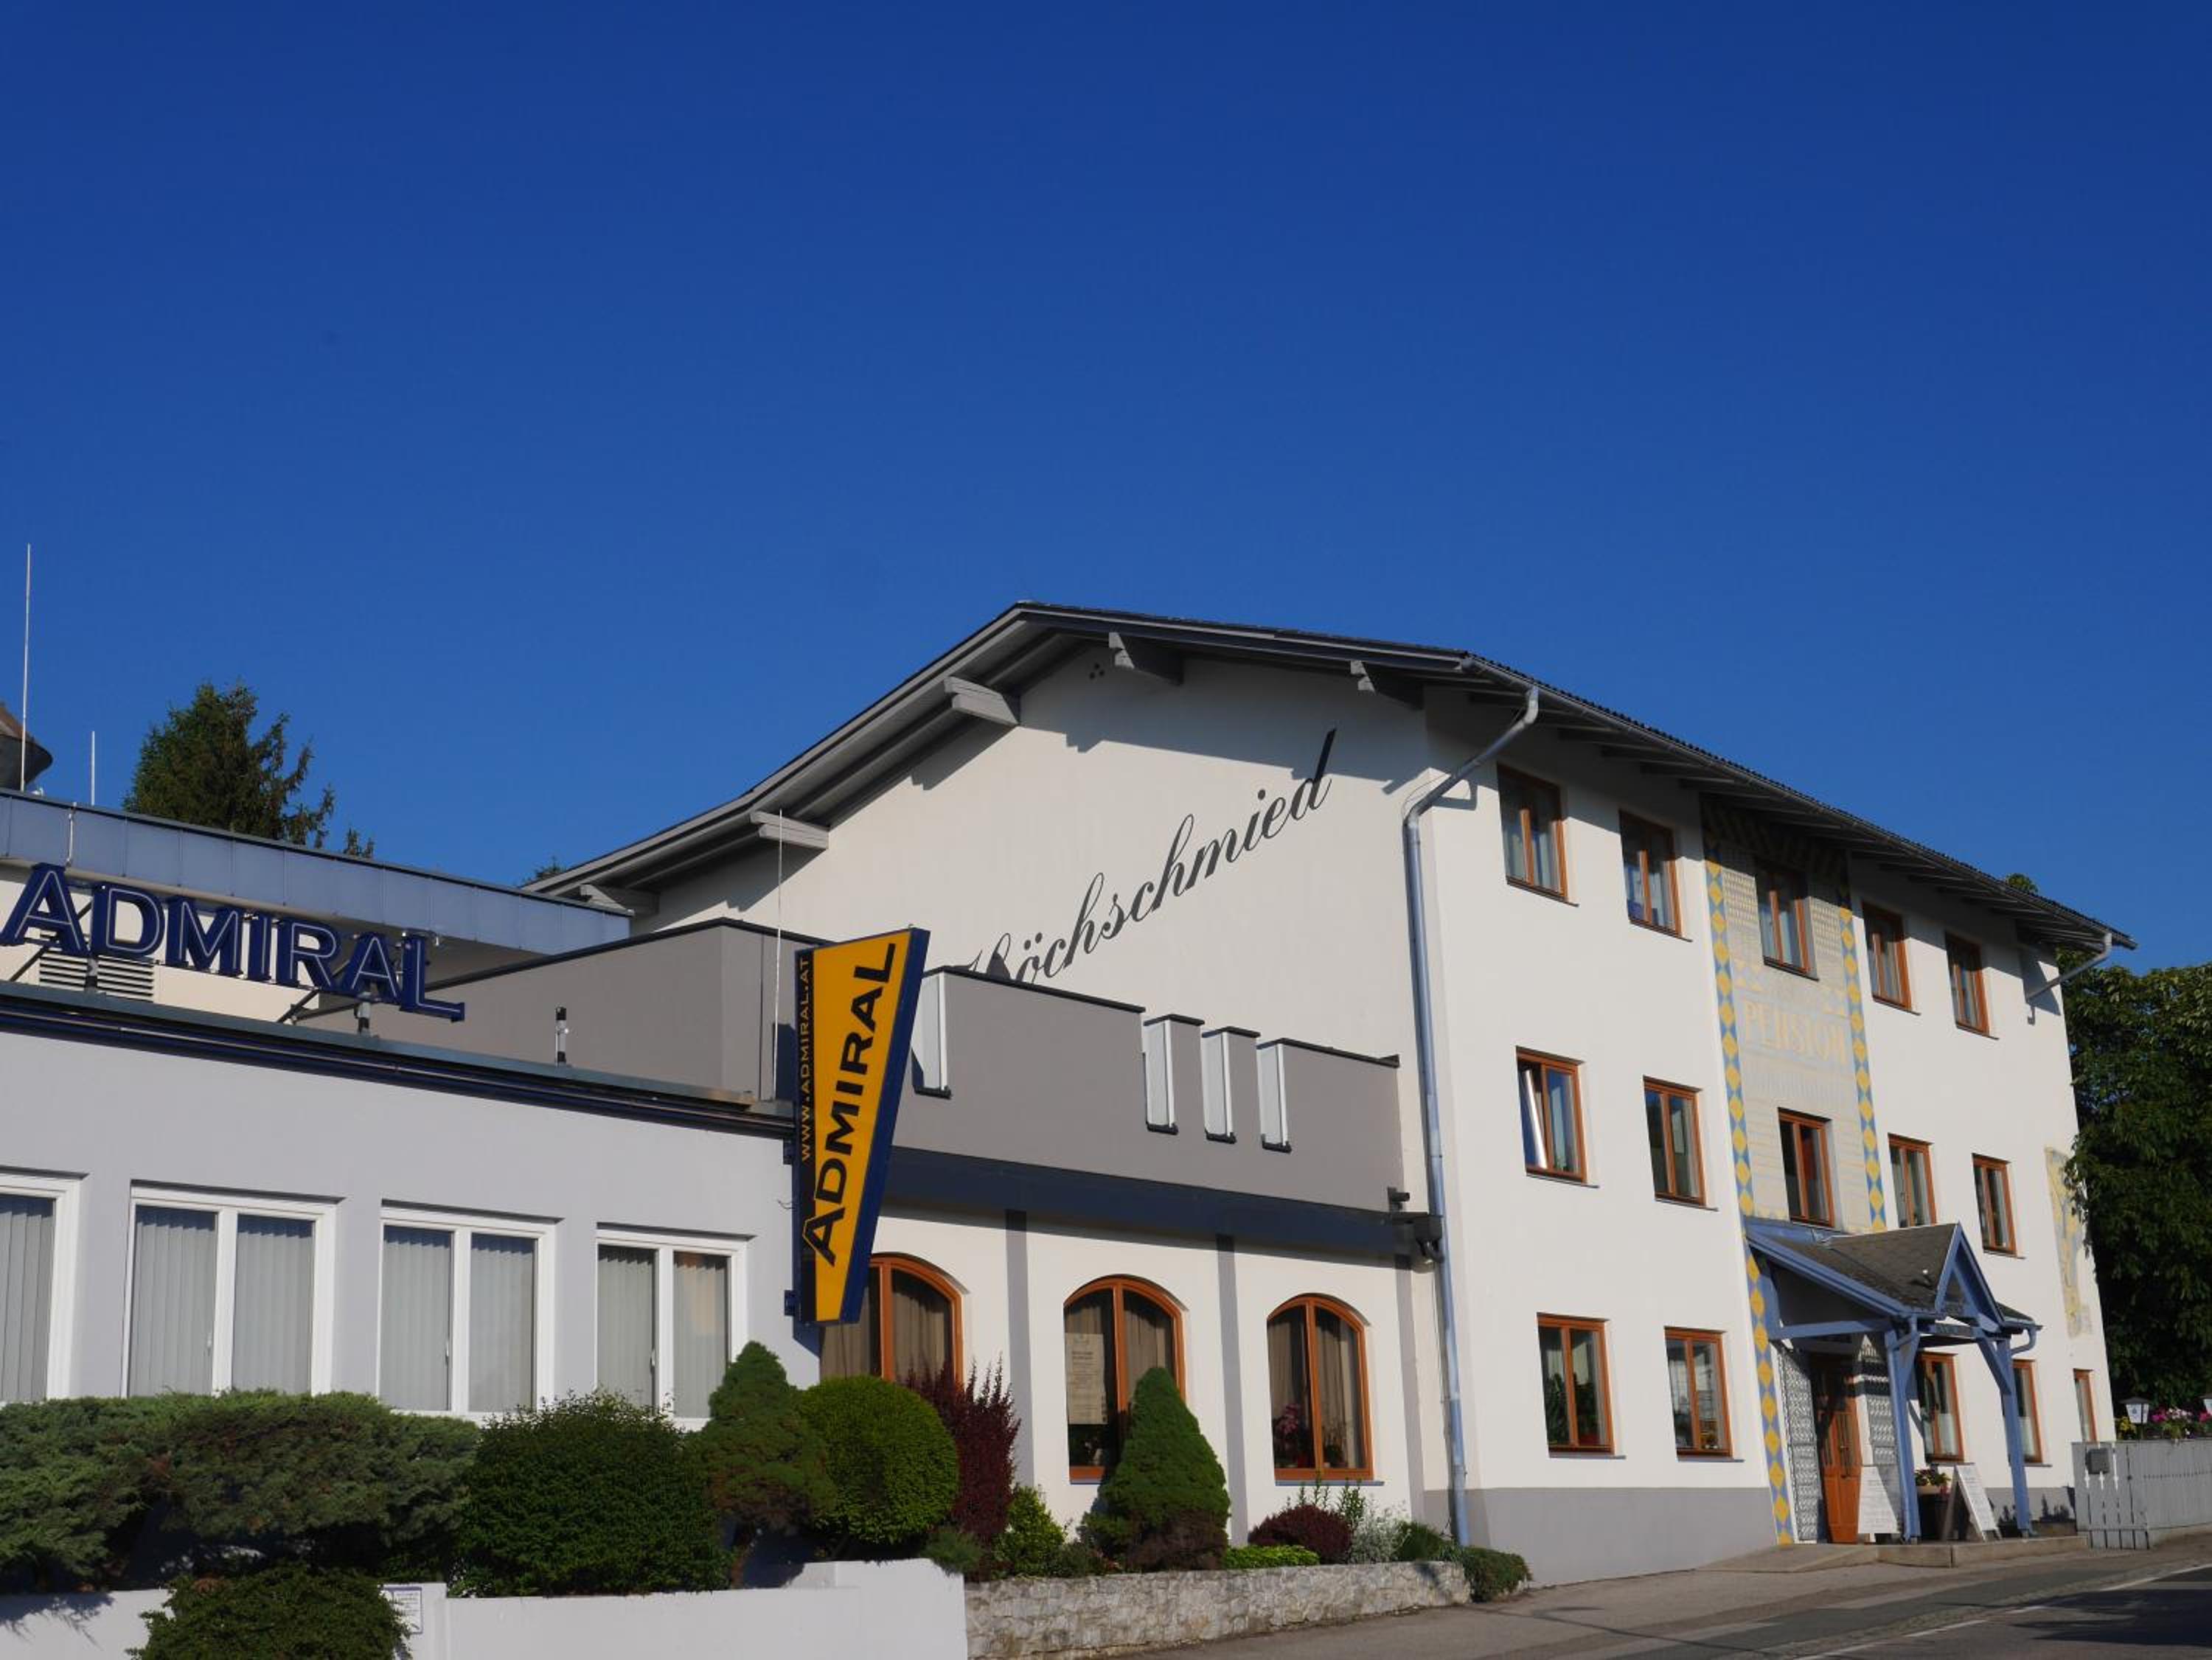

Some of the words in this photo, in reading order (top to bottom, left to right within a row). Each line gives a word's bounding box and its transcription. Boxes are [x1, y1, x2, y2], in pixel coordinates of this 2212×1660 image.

[0, 862, 465, 1022] ADMIRAL
[1745, 1000, 1847, 1066] PENSION
[800, 957, 810, 1162] WWW.ADMIRAL.AT
[803, 943, 896, 1266] ADMIRAL
